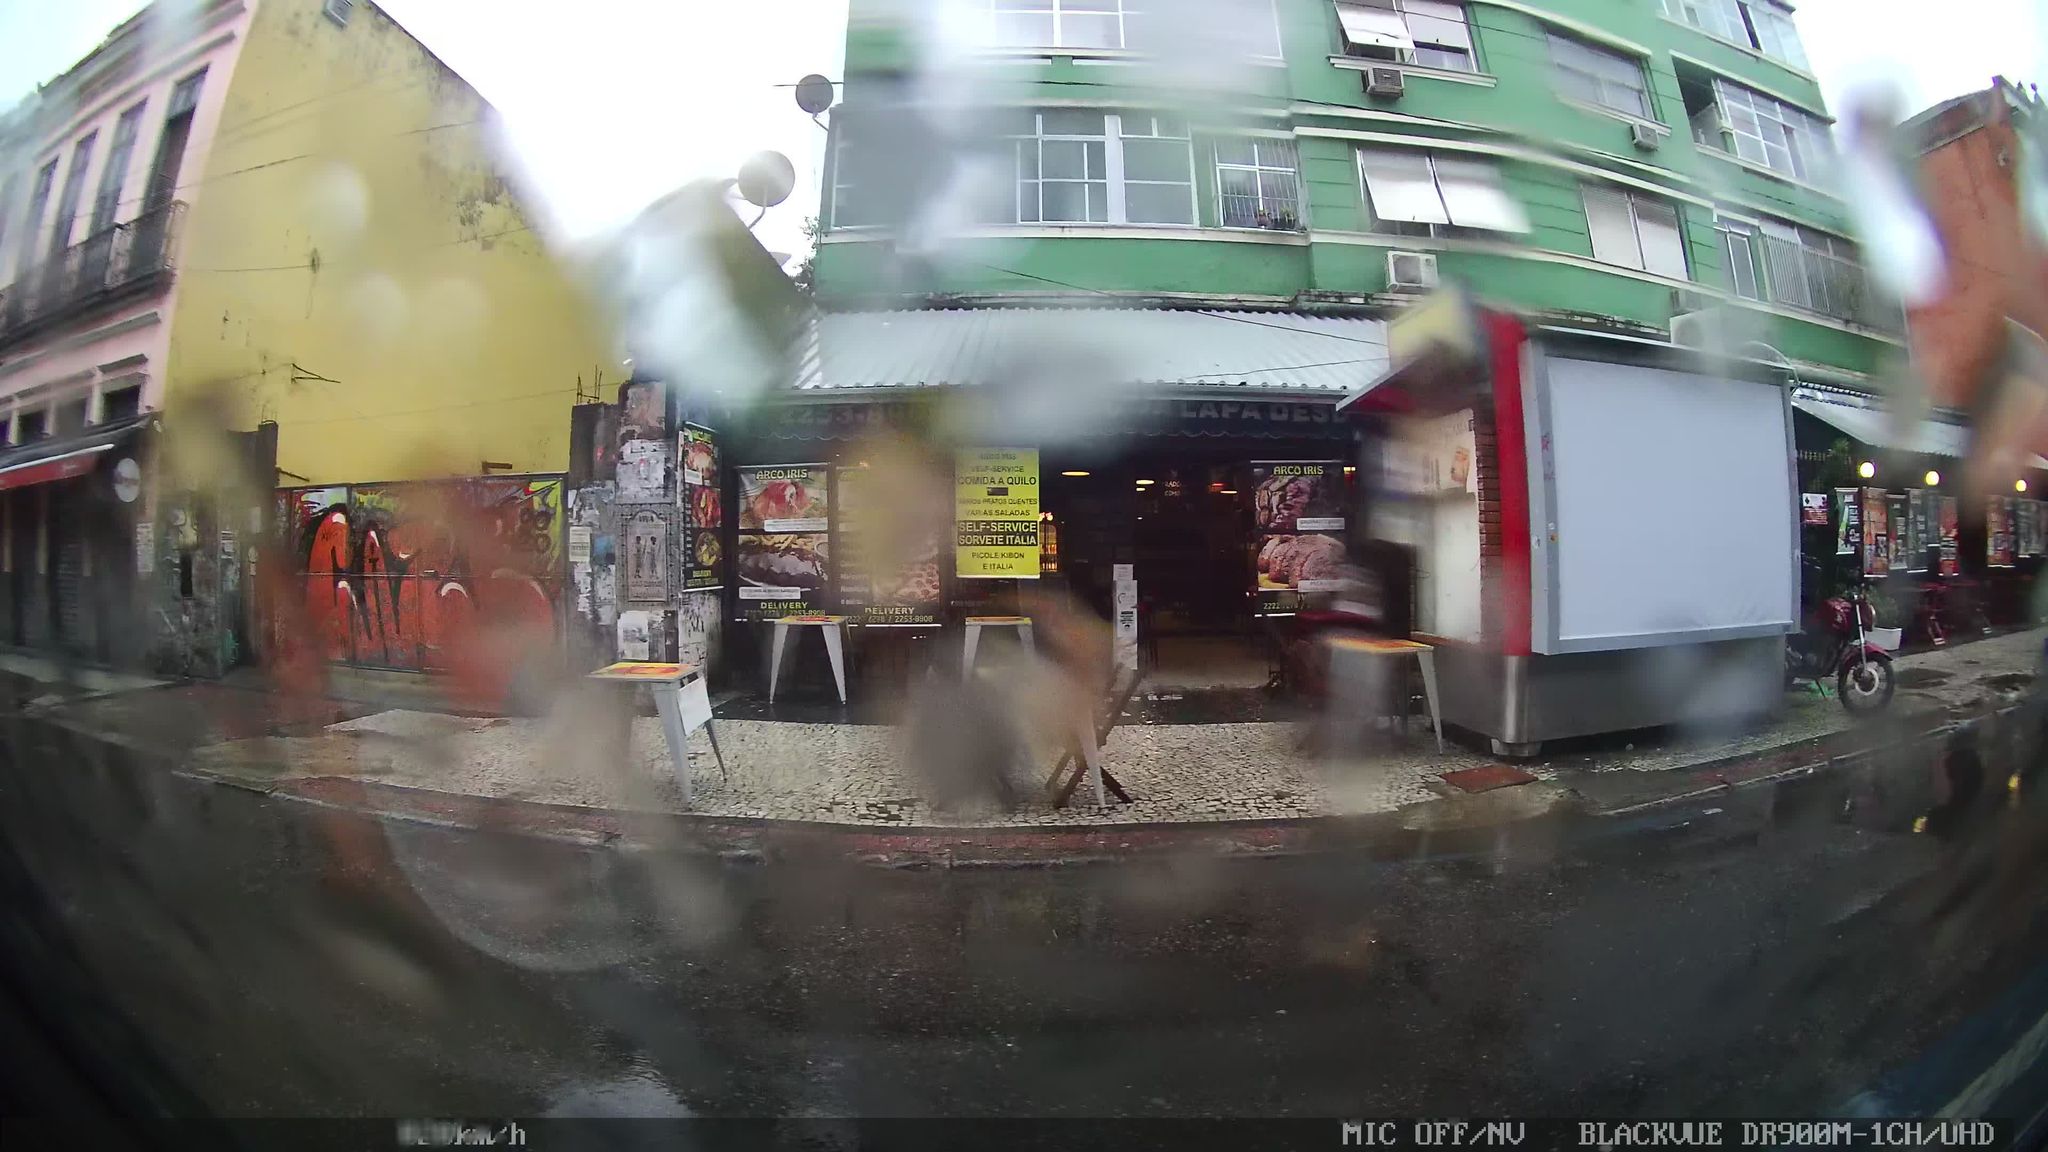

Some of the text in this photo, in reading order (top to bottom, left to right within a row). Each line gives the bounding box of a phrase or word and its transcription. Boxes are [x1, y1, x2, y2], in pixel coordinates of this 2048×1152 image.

[1180, 402, 1262, 419] LAPA
[756, 469, 808, 480] ARCO IRIS
[1273, 466, 1324, 475] ARCO IRIS
[959, 476, 1037, 485] COMIDA A QUILO
[959, 522, 1037, 532] SELF-SERVICE
[959, 535, 1005, 545] SORVETE
[864, 607, 915, 615] DELIVERY
